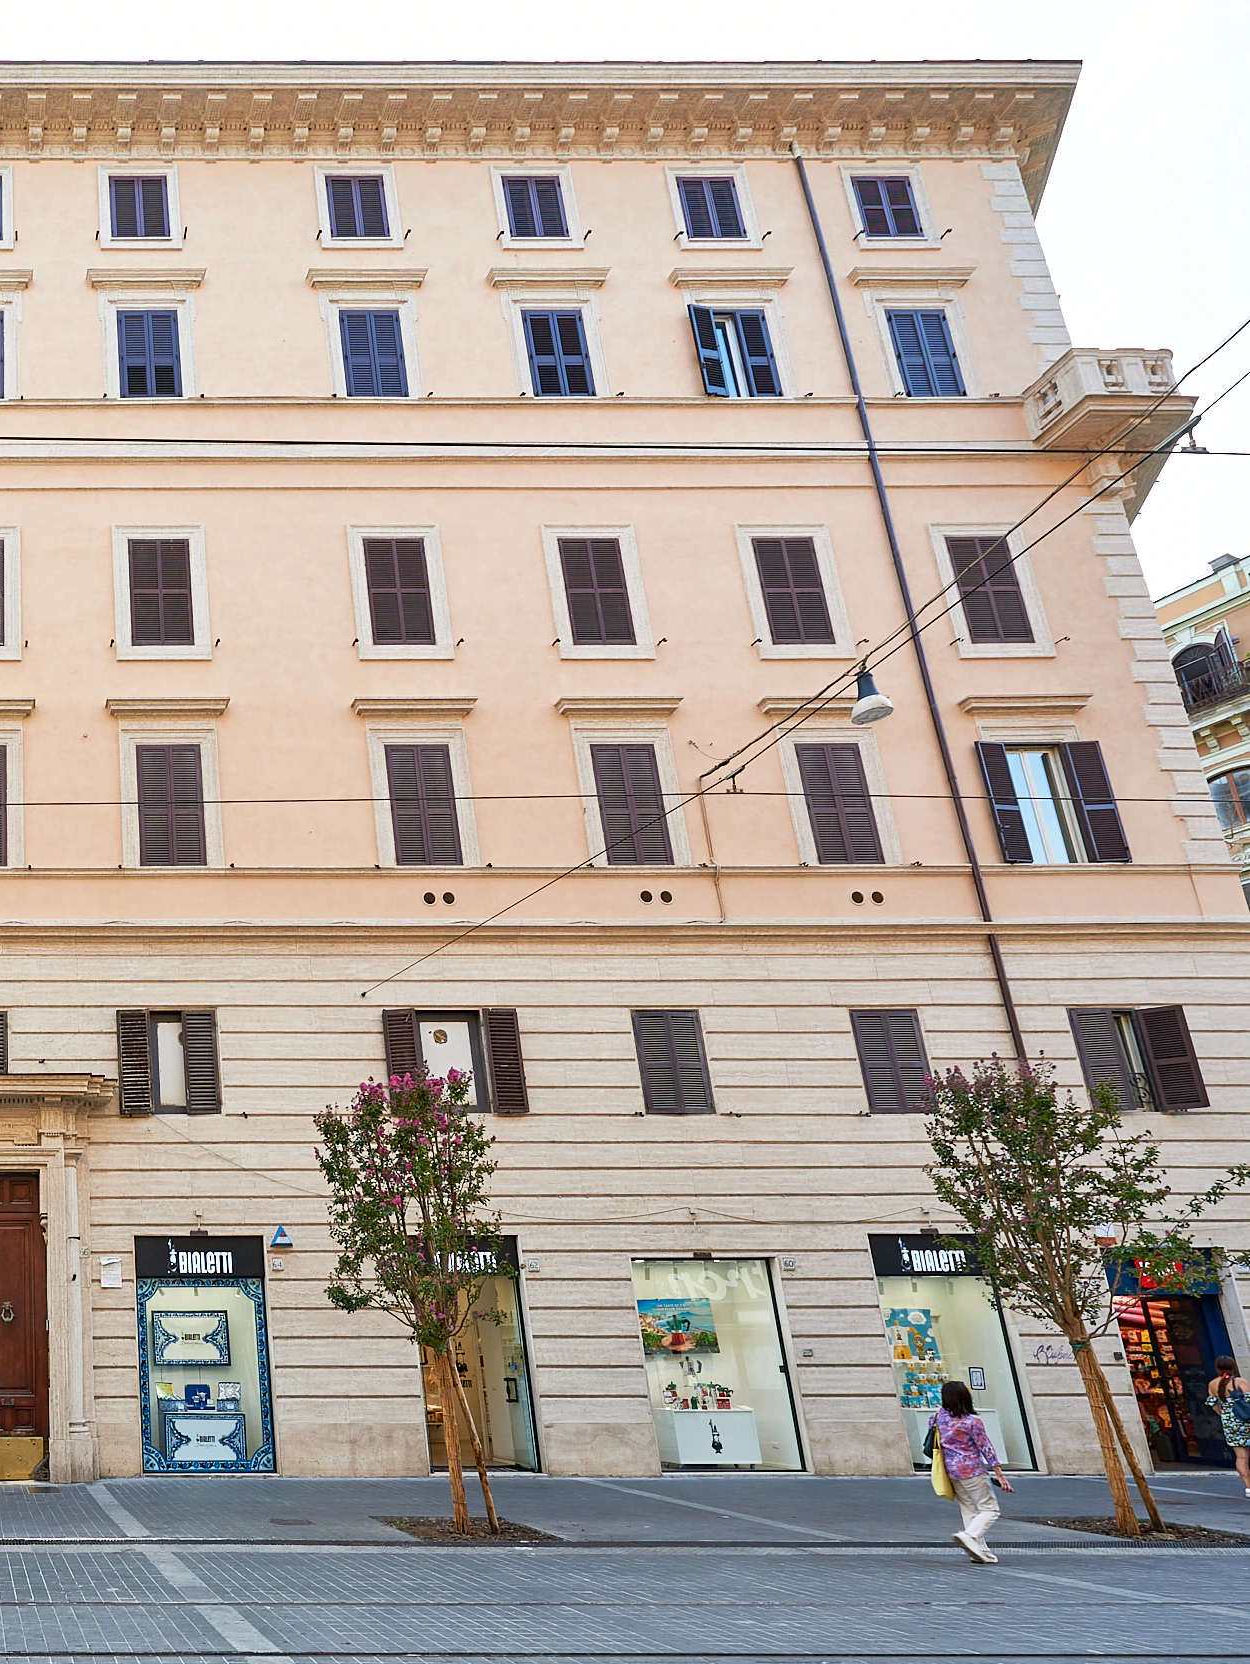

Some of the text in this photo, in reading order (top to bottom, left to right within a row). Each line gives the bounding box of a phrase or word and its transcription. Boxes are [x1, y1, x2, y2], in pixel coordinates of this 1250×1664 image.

[178, 1251, 234, 1274] BIALETTI
[784, 1260, 794, 1268] 60
[911, 1249, 967, 1272] BIALETTI
